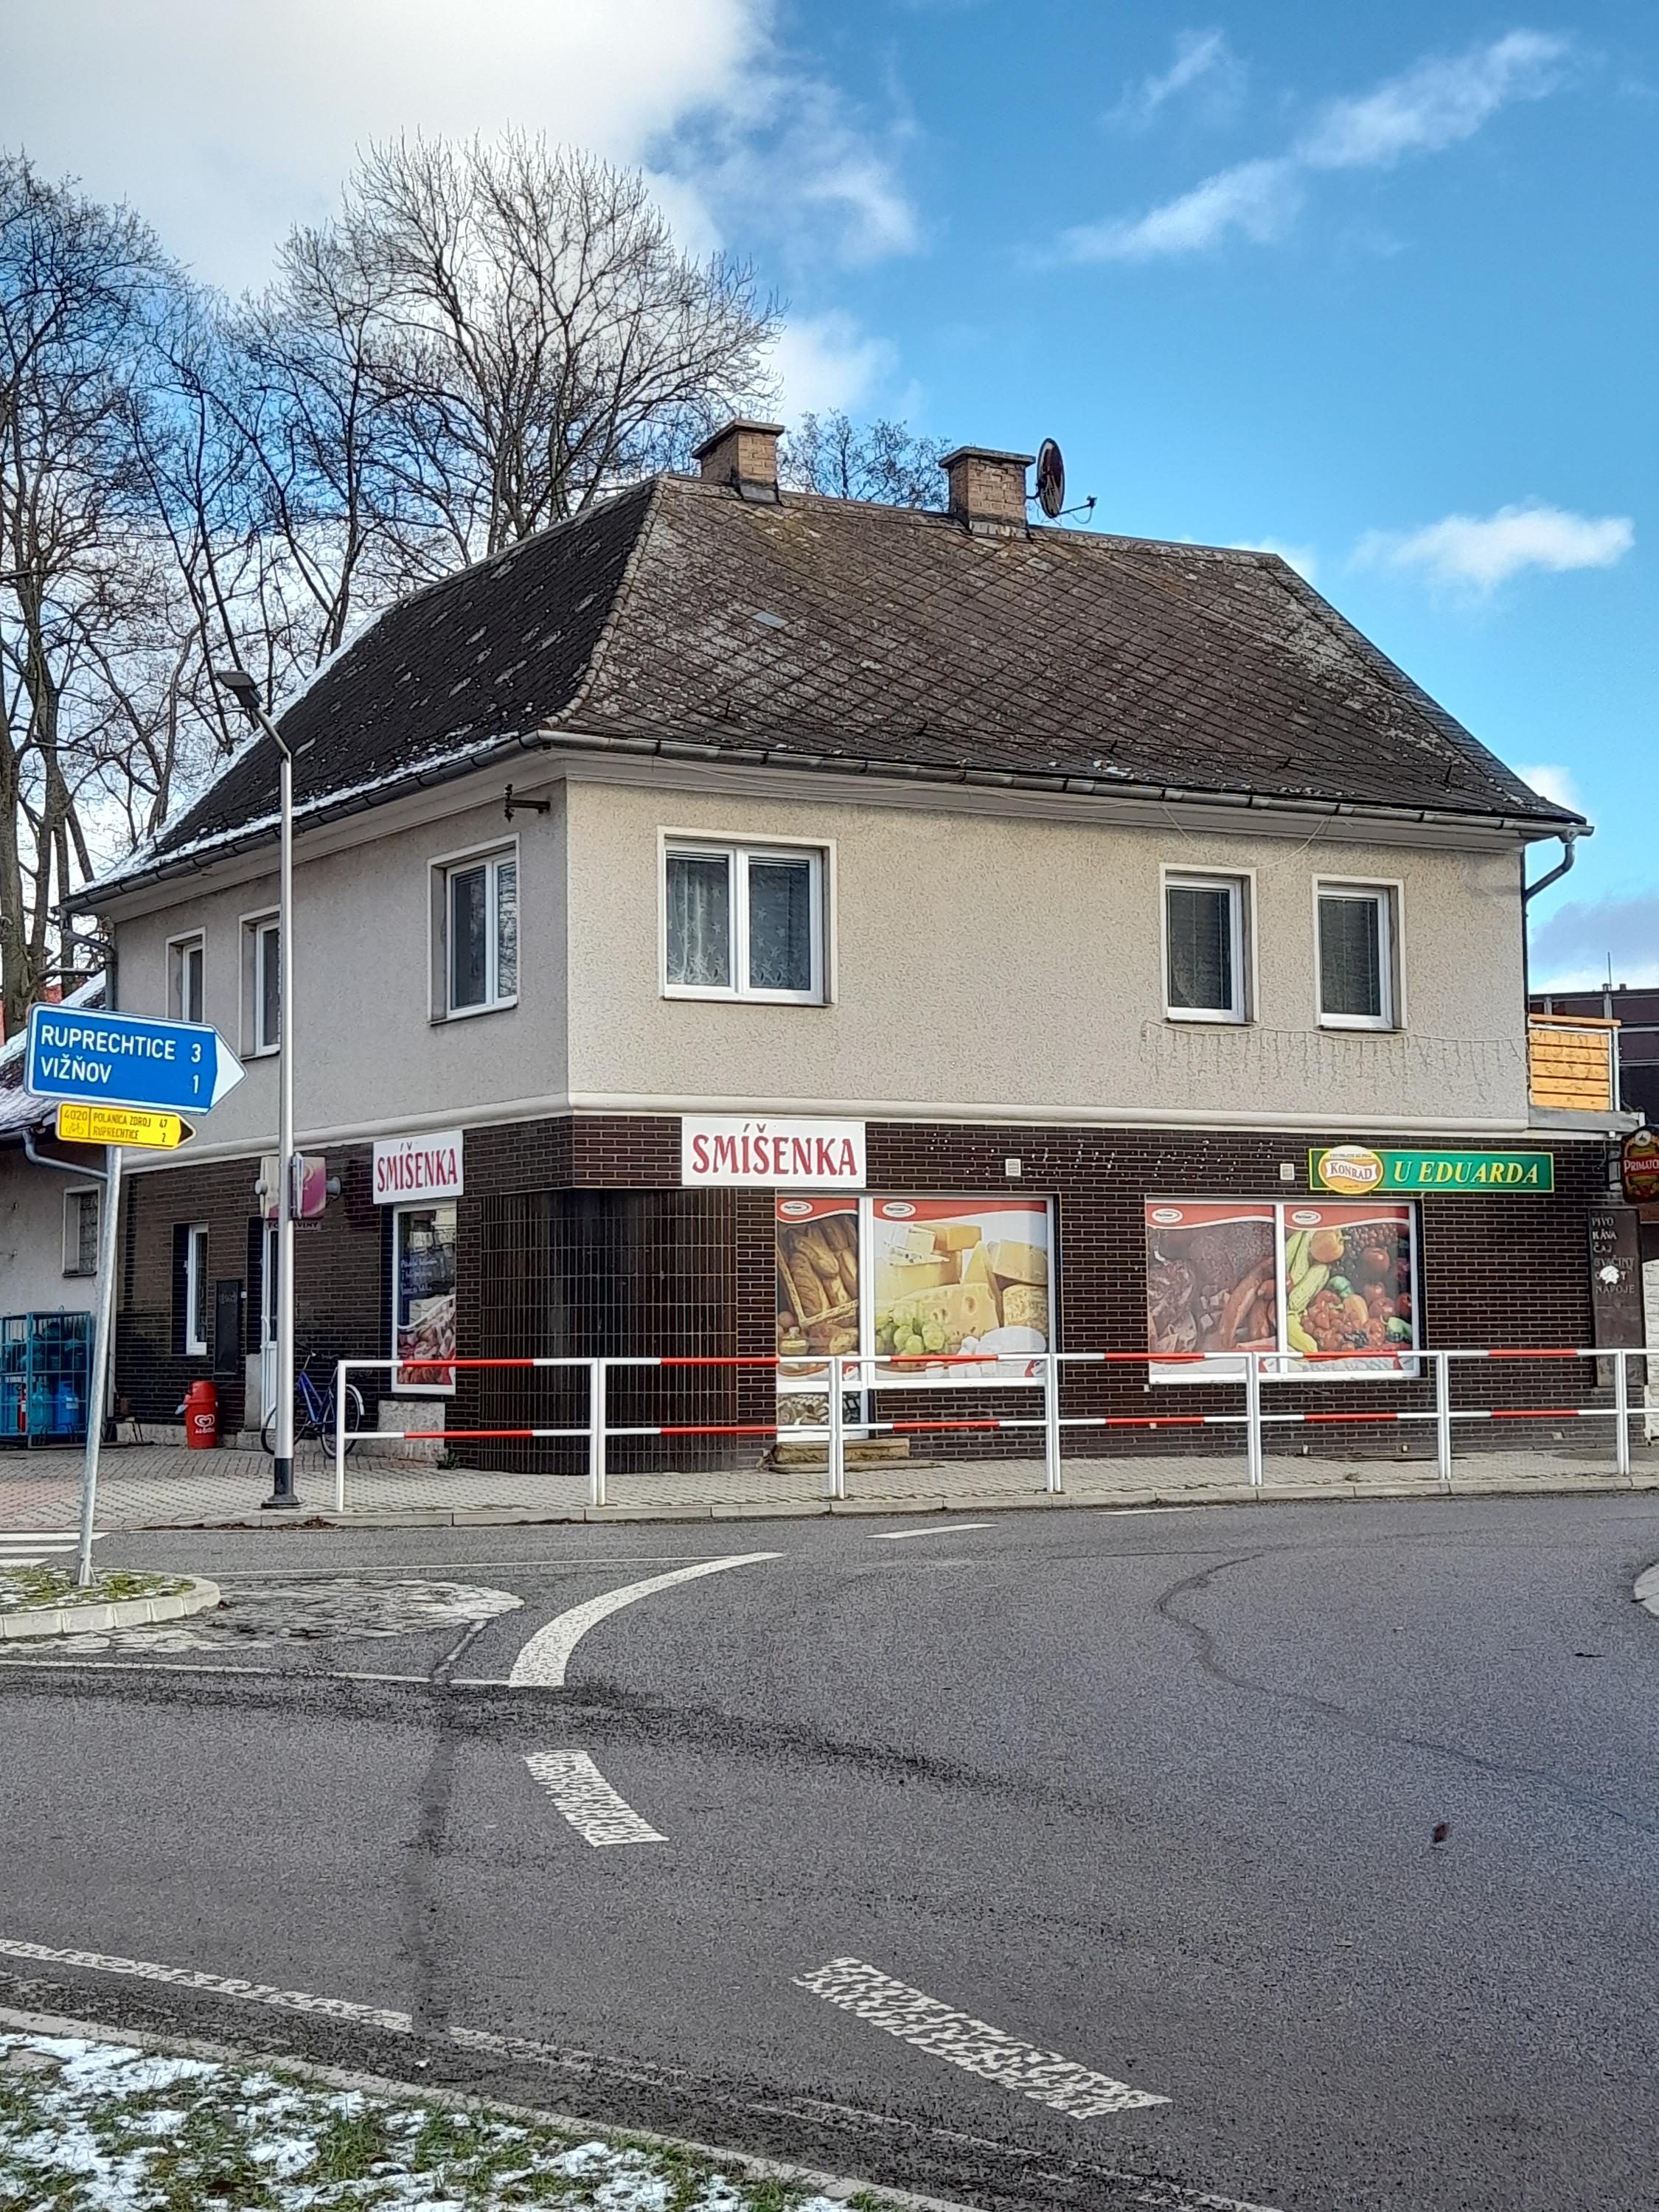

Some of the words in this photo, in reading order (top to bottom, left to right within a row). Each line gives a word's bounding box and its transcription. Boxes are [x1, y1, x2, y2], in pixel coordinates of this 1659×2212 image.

[41, 1025, 176, 1060] RUPRECHTICE
[191, 1043, 201, 1063] 3
[41, 1054, 112, 1084] VIŽŇOV
[192, 1074, 199, 1094] 1
[63, 1110, 87, 1121] 4020
[93, 1112, 128, 1125] POLANICA
[93, 1126, 140, 1140] RUPRECHTICE
[161, 1133, 167, 1142] 2
[692, 1123, 857, 1176] SMÍŠENKA
[377, 1141, 458, 1192] SMÍŠENKA
[1329, 1162, 1372, 1180] KONRAD
[1394, 1161, 1412, 1182] U
[1419, 1161, 1539, 1184] EDUARDA
